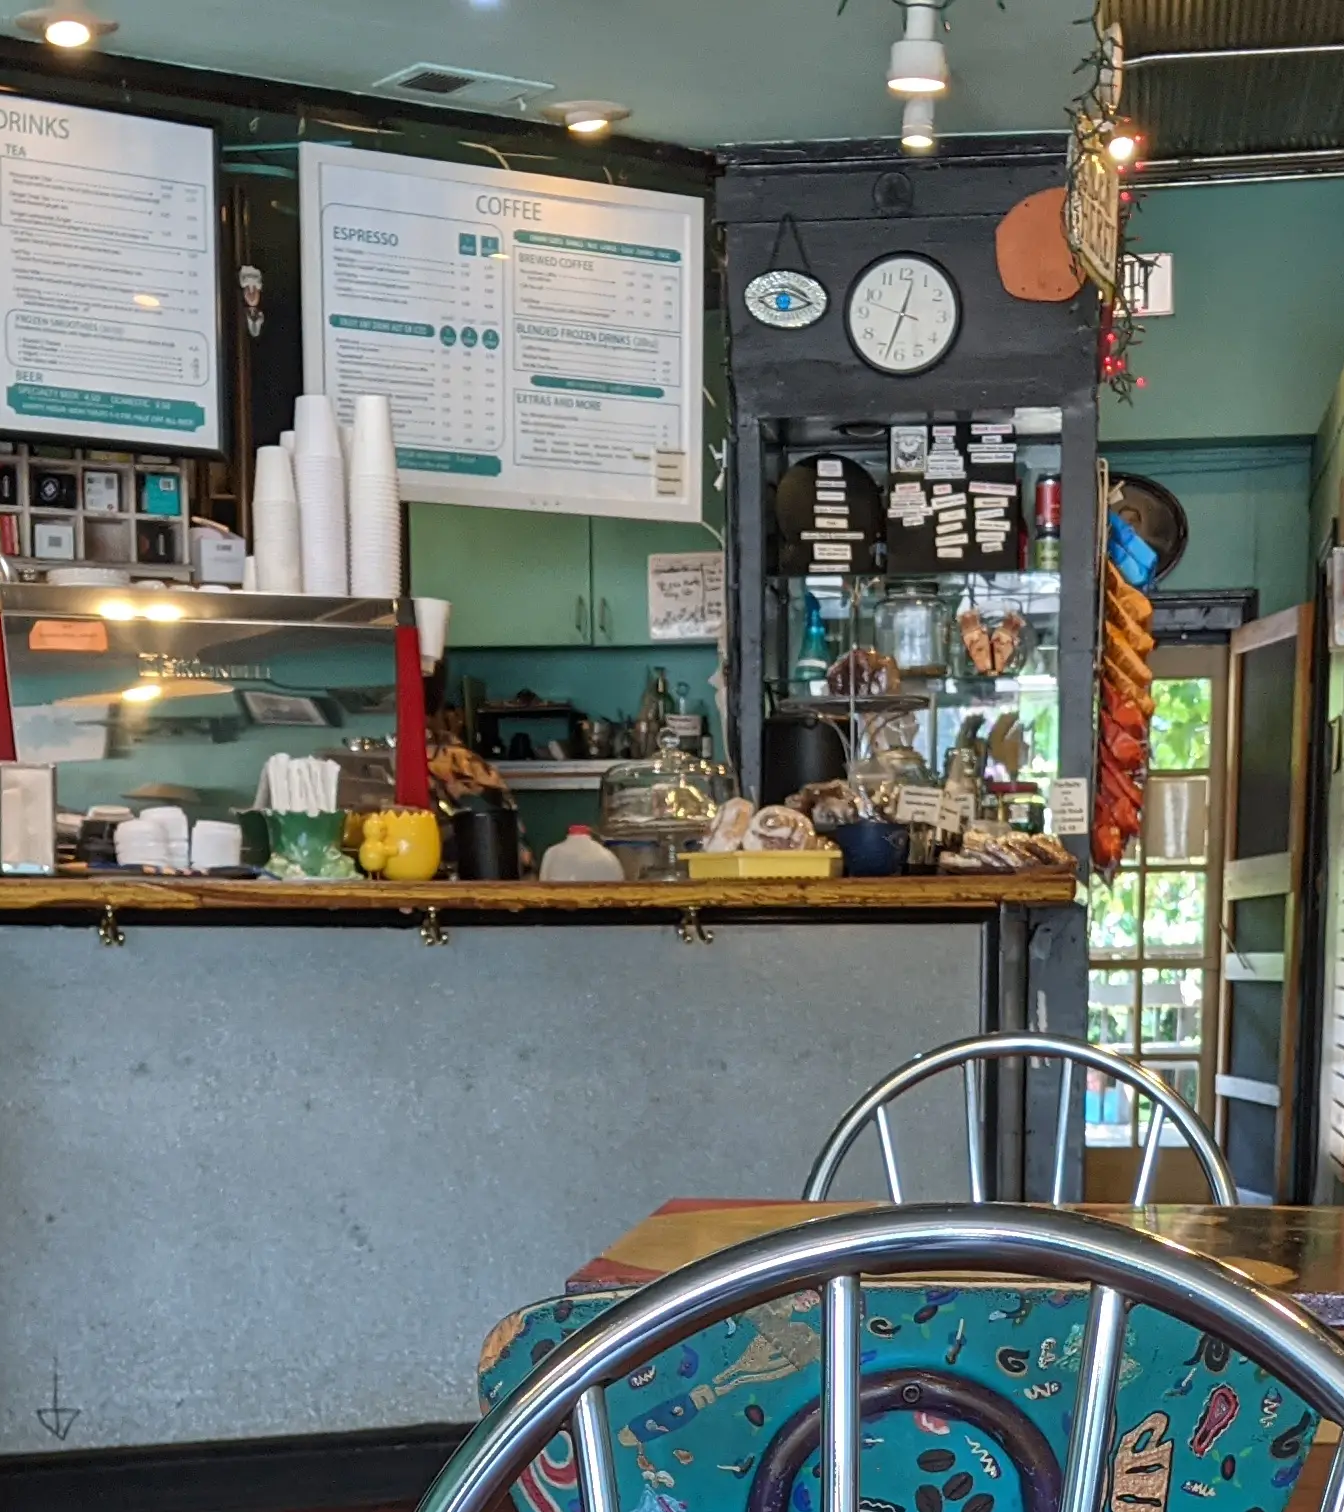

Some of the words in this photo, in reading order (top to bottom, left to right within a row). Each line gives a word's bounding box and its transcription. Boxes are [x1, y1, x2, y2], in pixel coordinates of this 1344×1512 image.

[5, 143, 27, 157] TEA
[475, 194, 542, 221] COFFEE
[333, 226, 398, 247] ESPRESSO
[519, 252, 556, 268] BREWED
[559, 257, 594, 271] COFFEE
[882, 272, 892, 286] 11
[899, 267, 914, 281] 12
[932, 289, 943, 302] 2
[858, 306, 870, 319] 9
[936, 310, 947, 323] 3
[517, 323, 558, 338] BLENDED
[561, 328, 596, 342] FROZEN
[599, 333, 630, 345] DRINKS
[862, 327, 874, 340] 8
[928, 332, 938, 344] 4
[877, 342, 887, 355] 7
[893, 347, 905, 361] 6
[913, 344, 924, 357] 5
[16, 369, 43, 383] BEER
[517, 393, 551, 406] EXTRAS
[575, 399, 601, 411] MORE
